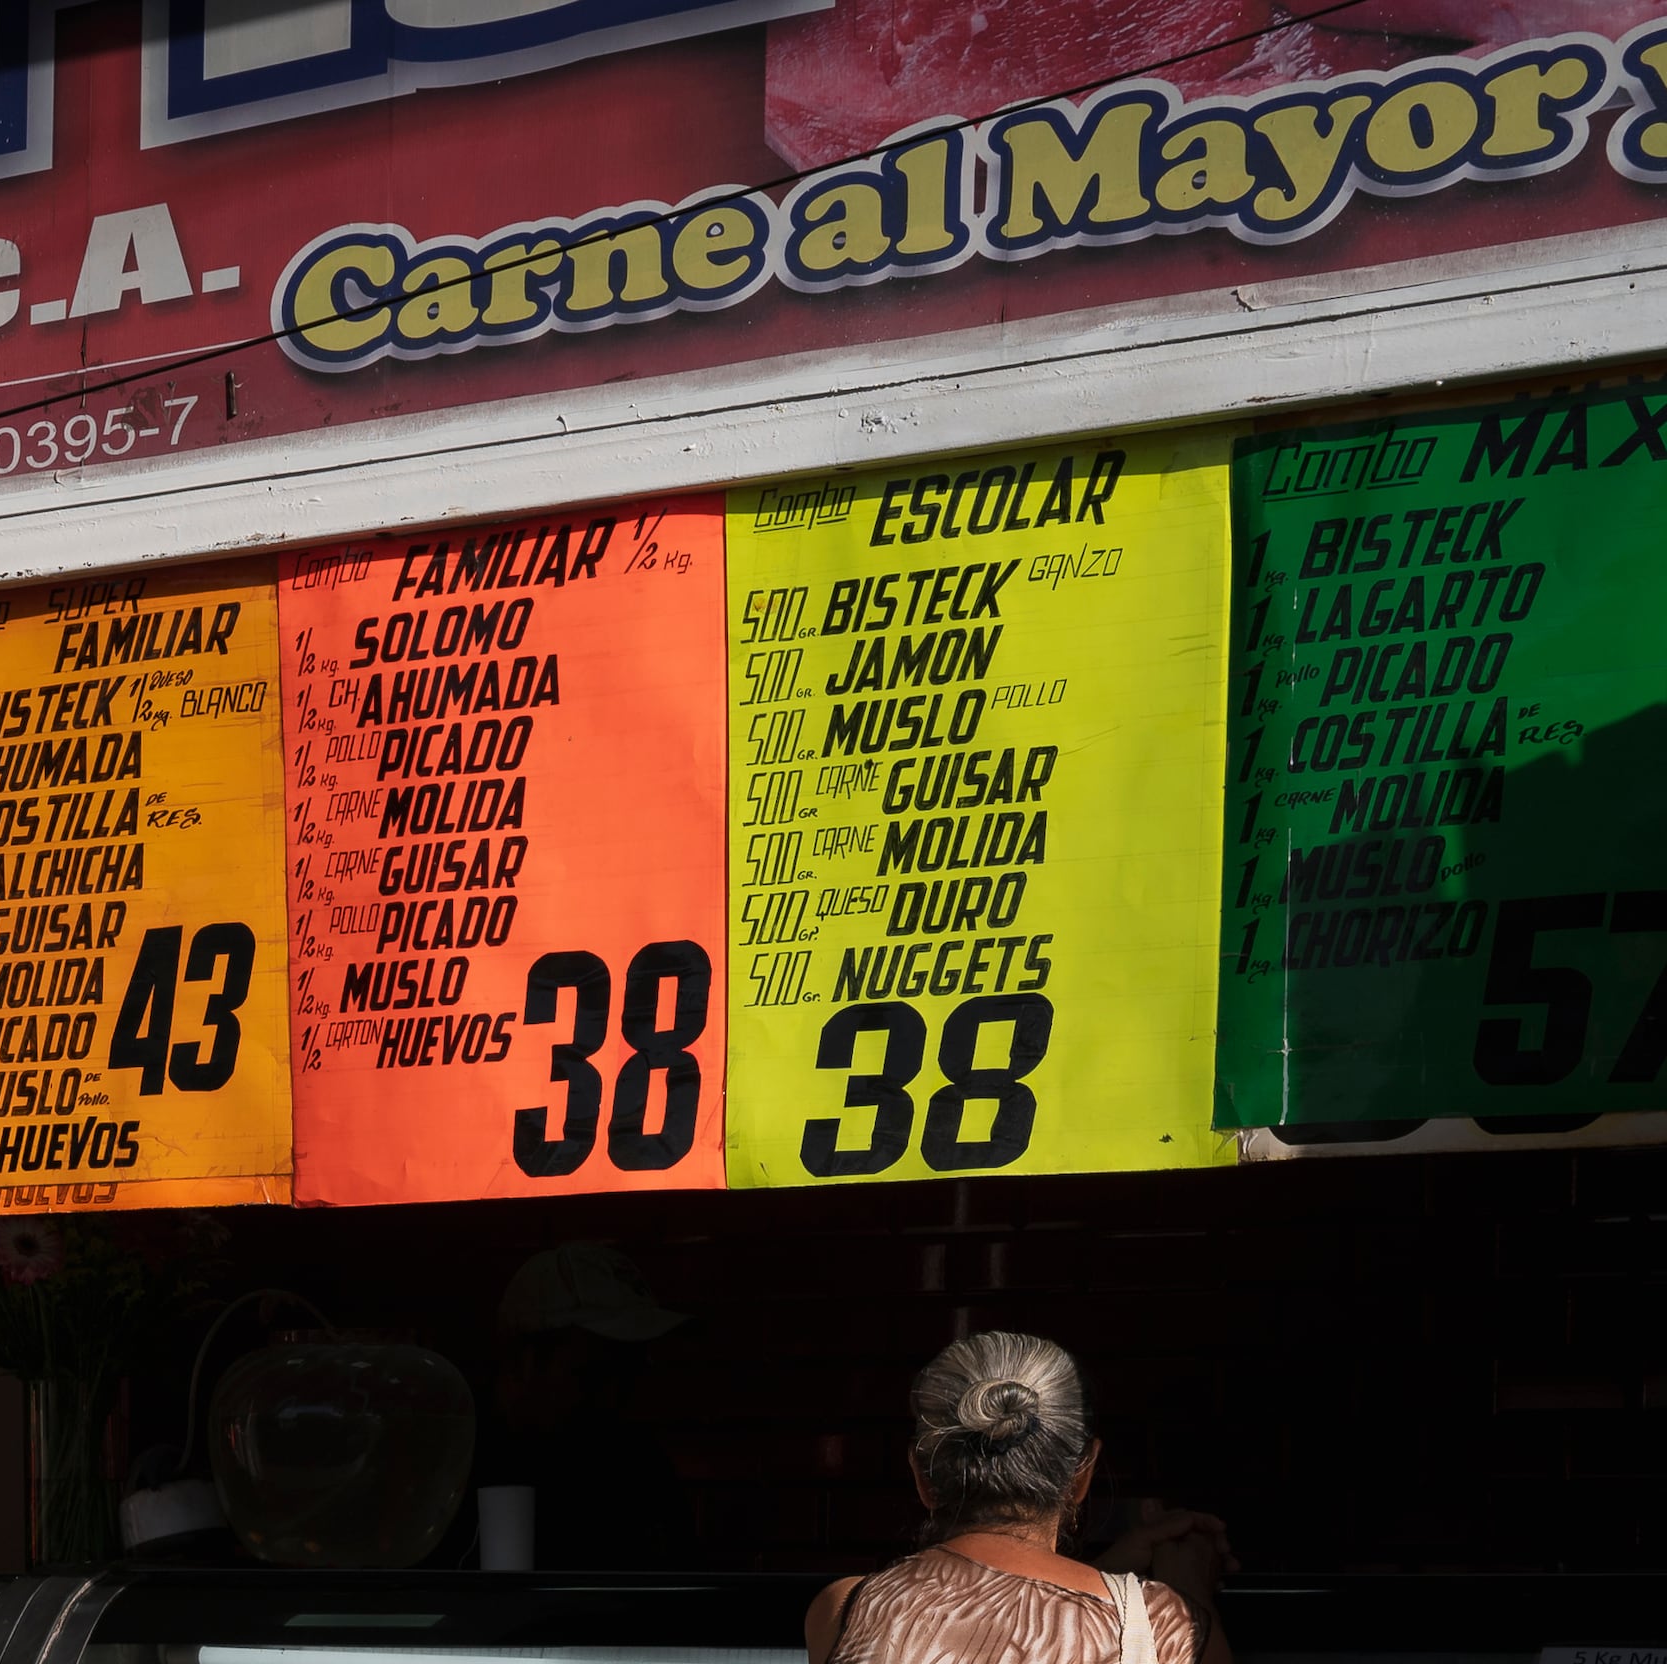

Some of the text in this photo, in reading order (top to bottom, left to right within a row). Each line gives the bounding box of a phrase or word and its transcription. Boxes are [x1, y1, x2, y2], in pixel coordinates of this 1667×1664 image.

[291, 200, 757, 353] Carne
[797, 127, 969, 272] al
[999, 56, 1590, 224] Mayor
[869, 450, 1128, 547] ESCOLAR
[392, 516, 618, 602] FAMILIAR
[53, 602, 240, 674] FAMILIAR
[349, 597, 535, 669] SOLOMO
[1295, 563, 1546, 644] LAGARTO
[180, 682, 268, 719] BLANCO
[377, 777, 527, 839] MOLIDA
[886, 872, 1028, 937] DURO
[1285, 900, 1489, 971] CHORIZO
[832, 934, 1055, 1003] NUGGETS
[1473, 892, 1667, 1085] 57
[107, 921, 257, 1098] 43
[513, 940, 712, 1177] 38
[800, 993, 1056, 1178] 38
